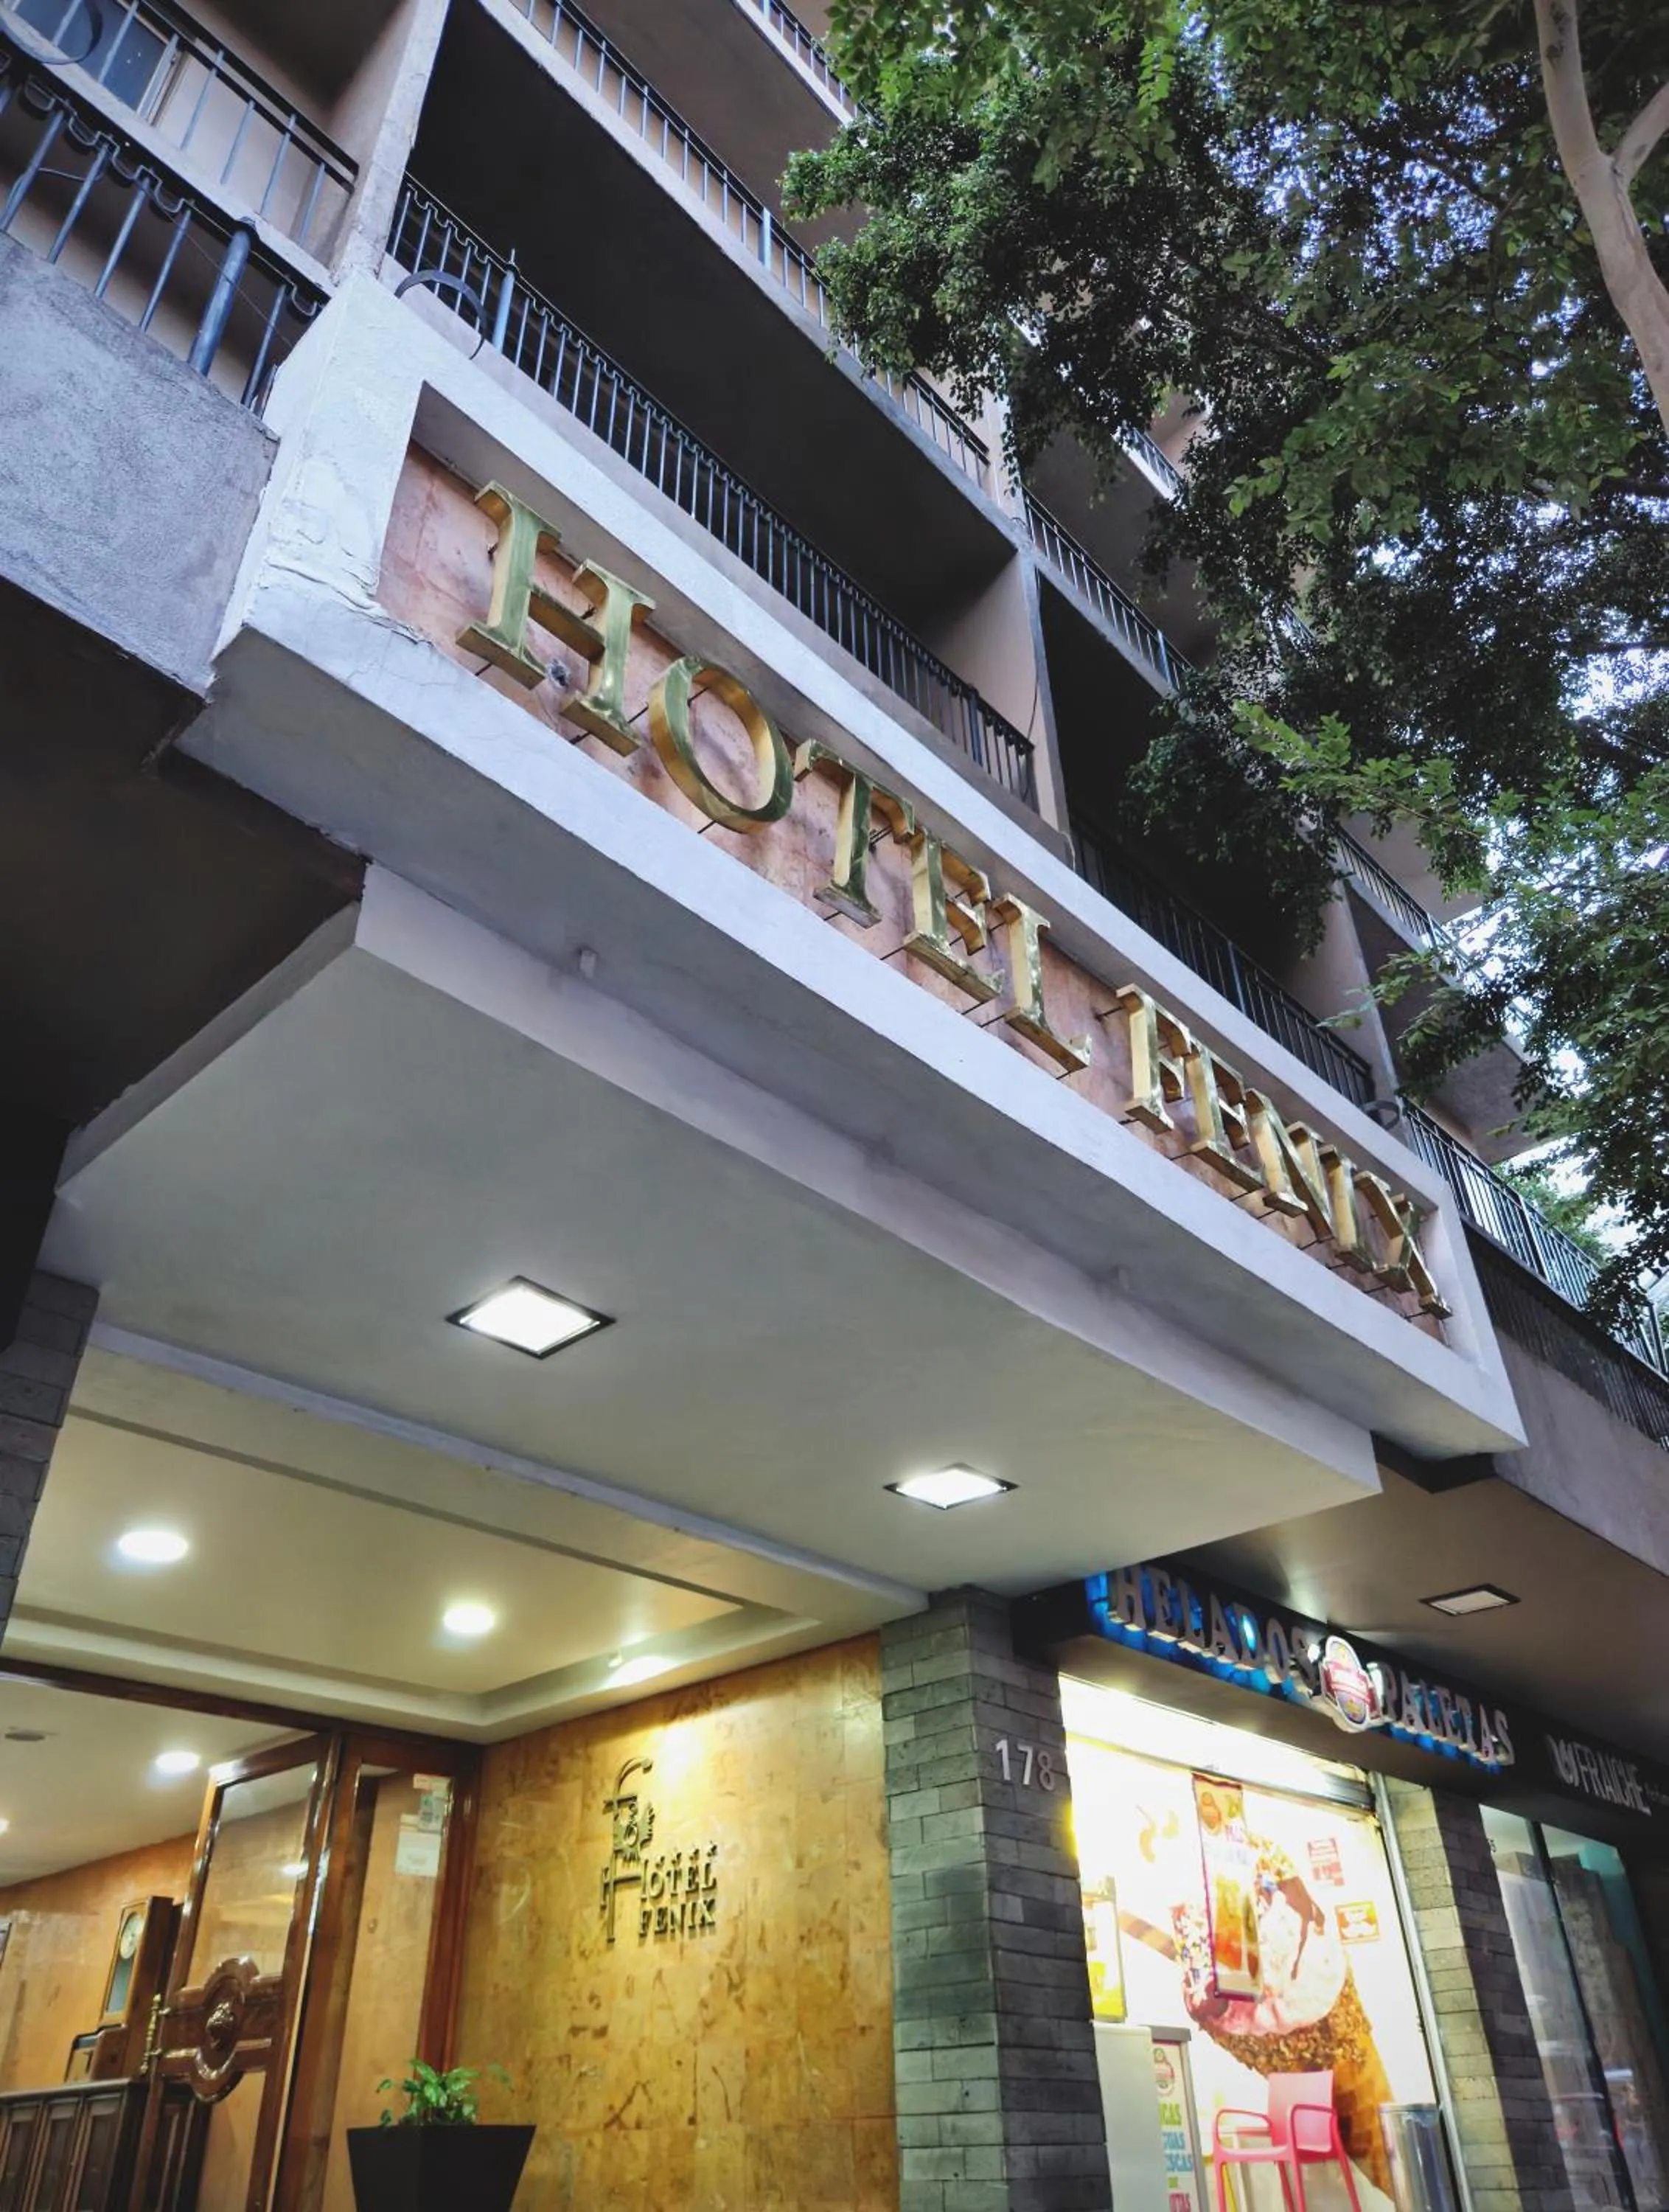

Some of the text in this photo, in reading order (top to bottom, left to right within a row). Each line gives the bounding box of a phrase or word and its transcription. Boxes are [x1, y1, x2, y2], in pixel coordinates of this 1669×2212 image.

[456, 480, 1452, 1319] HOTEL FENIX
[1107, 1563, 1320, 1694] HELADOS
[1377, 1661, 1515, 1766] PALETAS
[995, 1738, 1056, 1792] 178
[638, 1898, 717, 1938] FENIX
